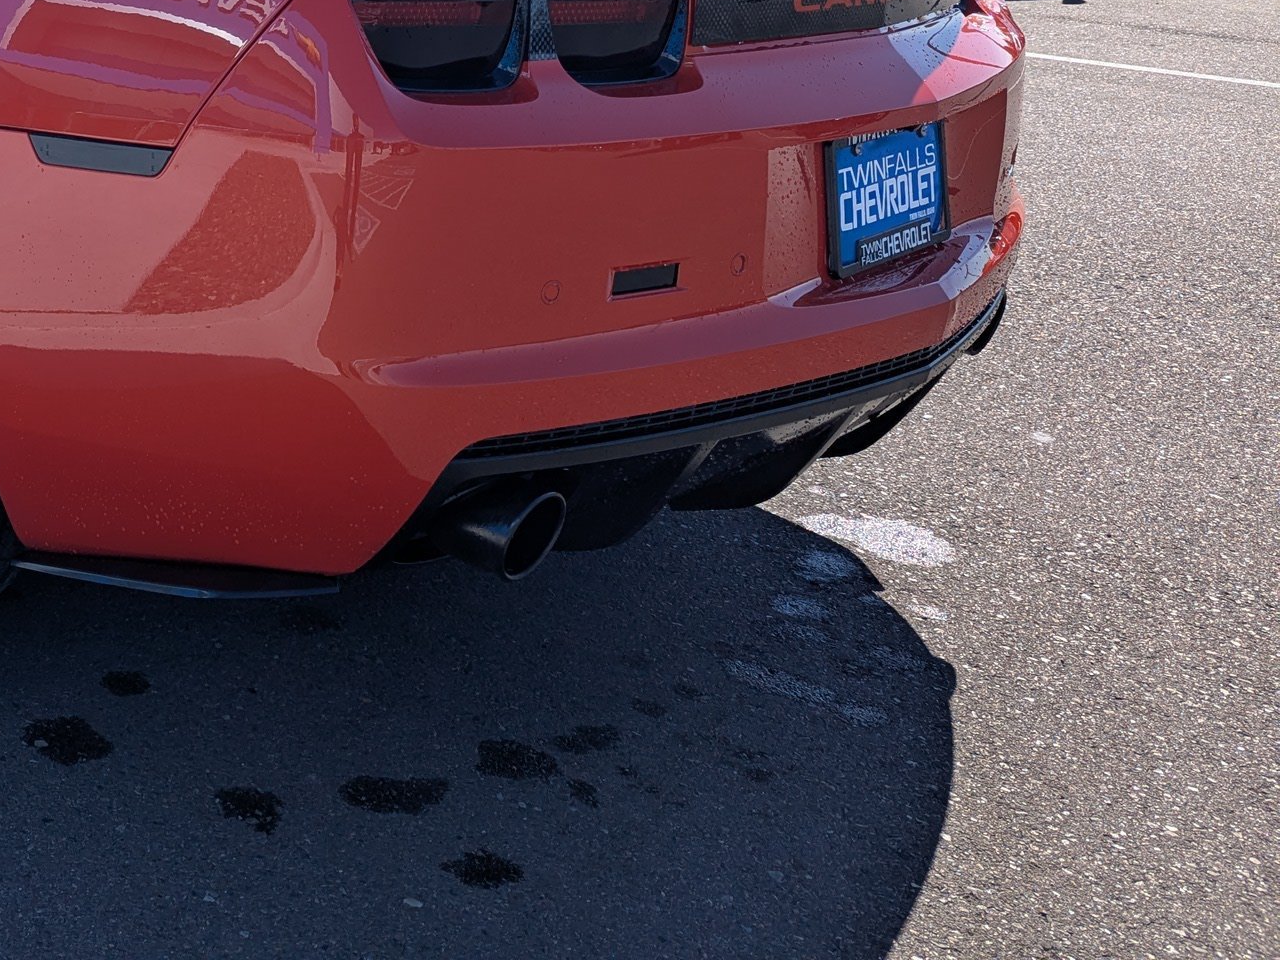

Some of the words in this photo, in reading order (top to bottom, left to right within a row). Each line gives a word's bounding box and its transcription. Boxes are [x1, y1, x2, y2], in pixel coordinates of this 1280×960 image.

[839, 165, 937, 232] CHEVROLET
[860, 239, 883, 255] TWIN
[881, 222, 932, 258] CHEVROLET
[861, 251, 883, 266] FALLS
